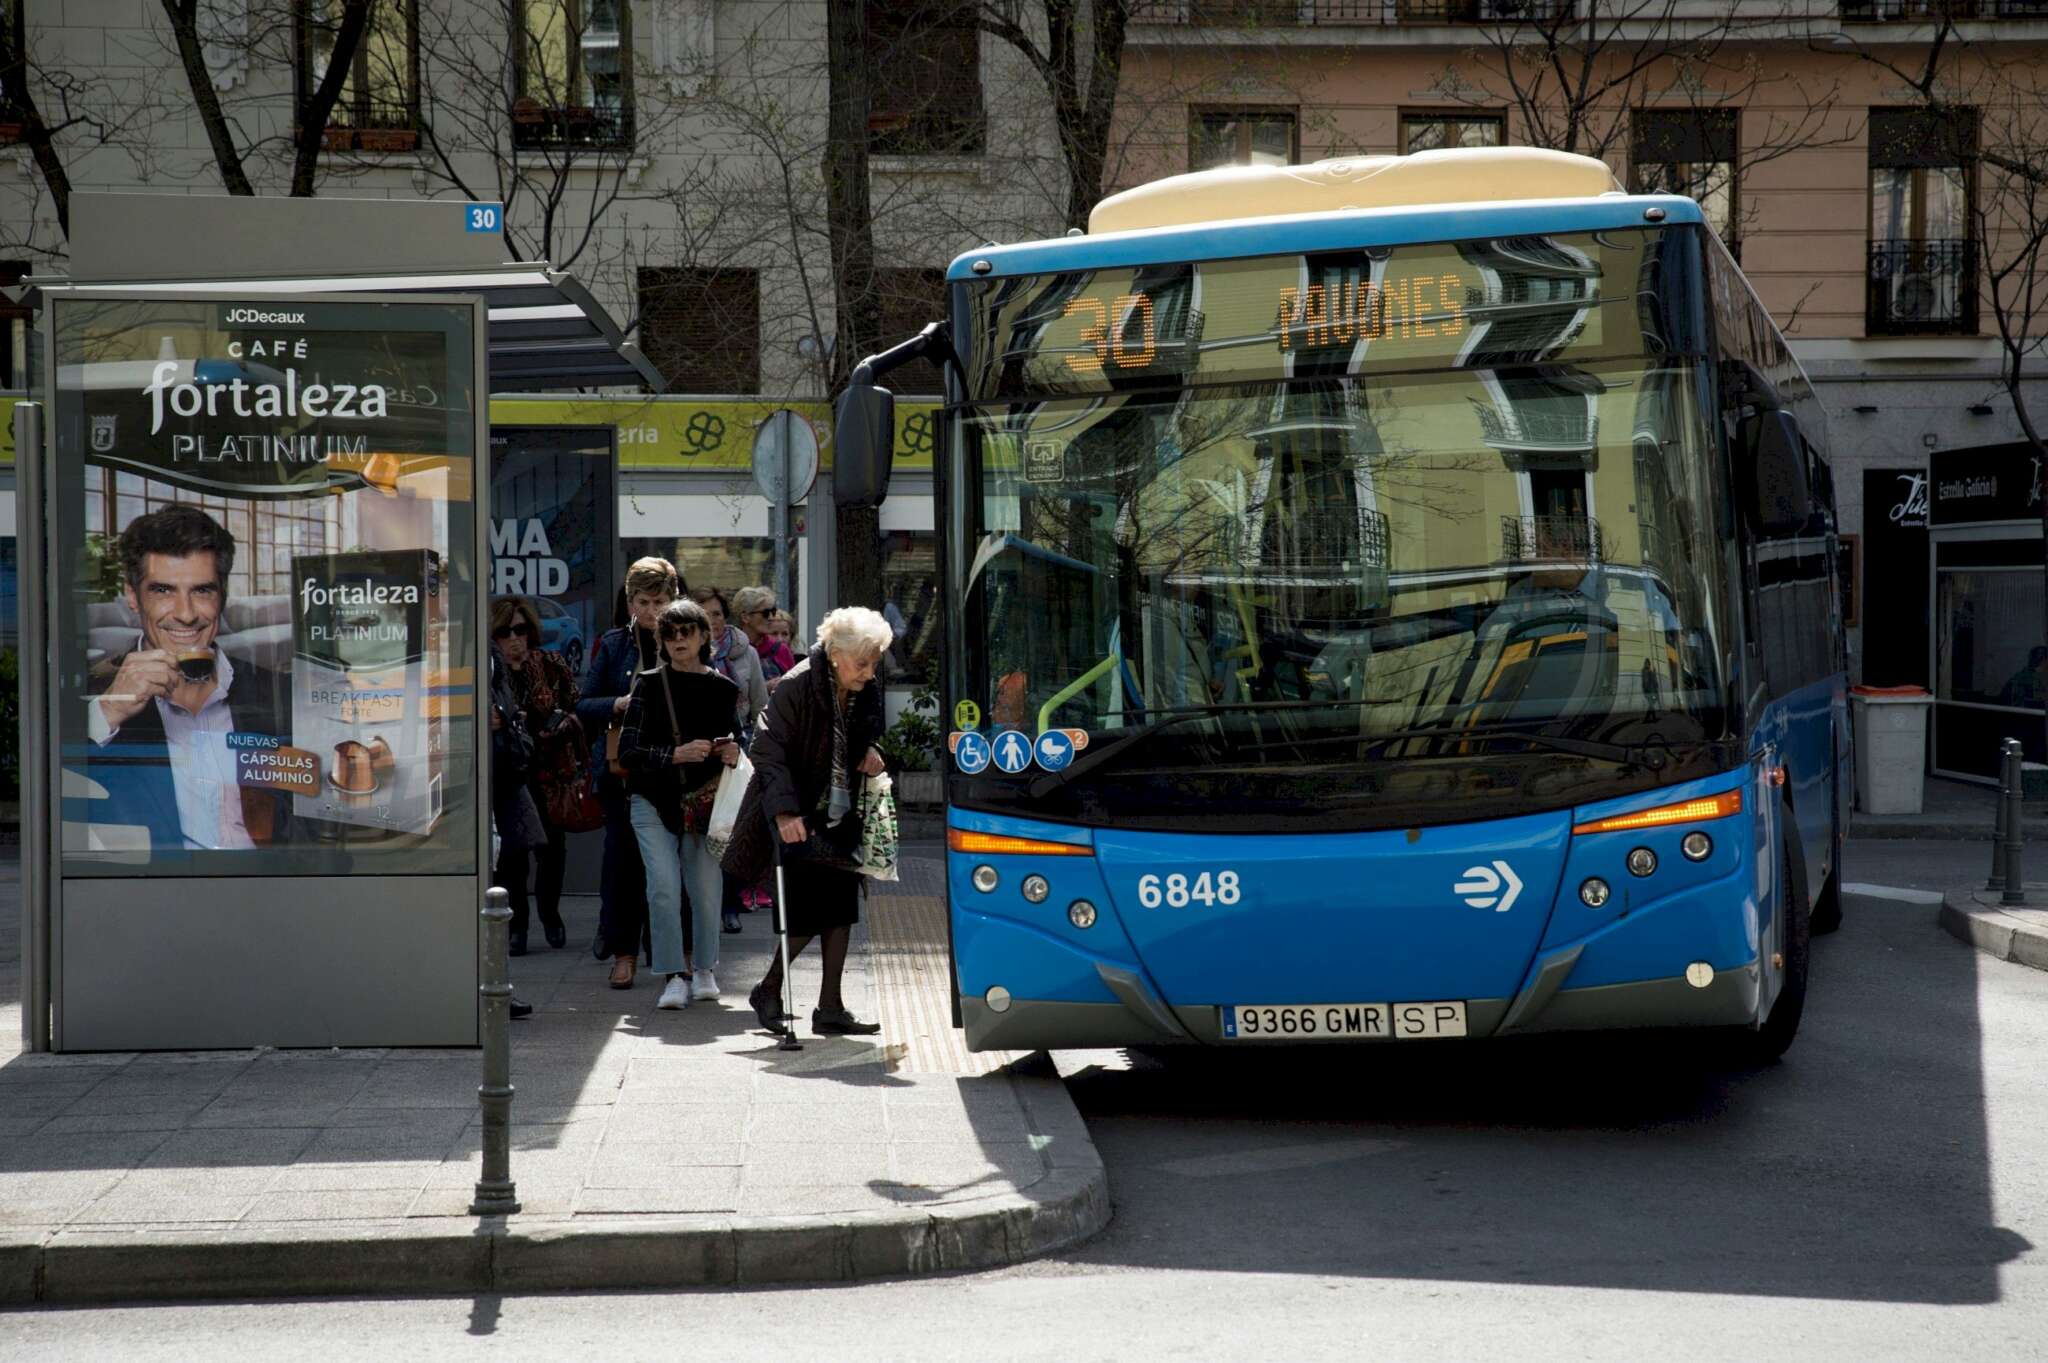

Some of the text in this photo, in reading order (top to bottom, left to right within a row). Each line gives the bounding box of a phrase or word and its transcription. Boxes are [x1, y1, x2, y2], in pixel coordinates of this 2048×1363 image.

[471, 208, 496, 229] 30
[225, 308, 306, 325] JCDecaux
[1064, 273, 1462, 372] 30 PAVONES
[227, 337, 309, 360] CAFÉ
[143, 361, 388, 436] fortaleza
[172, 434, 368, 463] PLATINIUM
[489, 557, 570, 596] RID
[299, 577, 420, 617] fortaleza
[310, 624, 408, 643] PLATINIUM
[310, 690, 404, 709] BREAKFAST
[340, 708, 373, 718] FORTE
[228, 734, 280, 750] NUEVAS
[1074, 731, 1084, 744] 2
[239, 750, 314, 770] CÁPSULAS
[243, 768, 314, 785] ALUMINIO
[376, 805, 391, 819] 12
[1137, 870, 1241, 910] 6848
[1243, 1008, 1317, 1034] 9366
[1325, 1006, 1382, 1034] GMR
